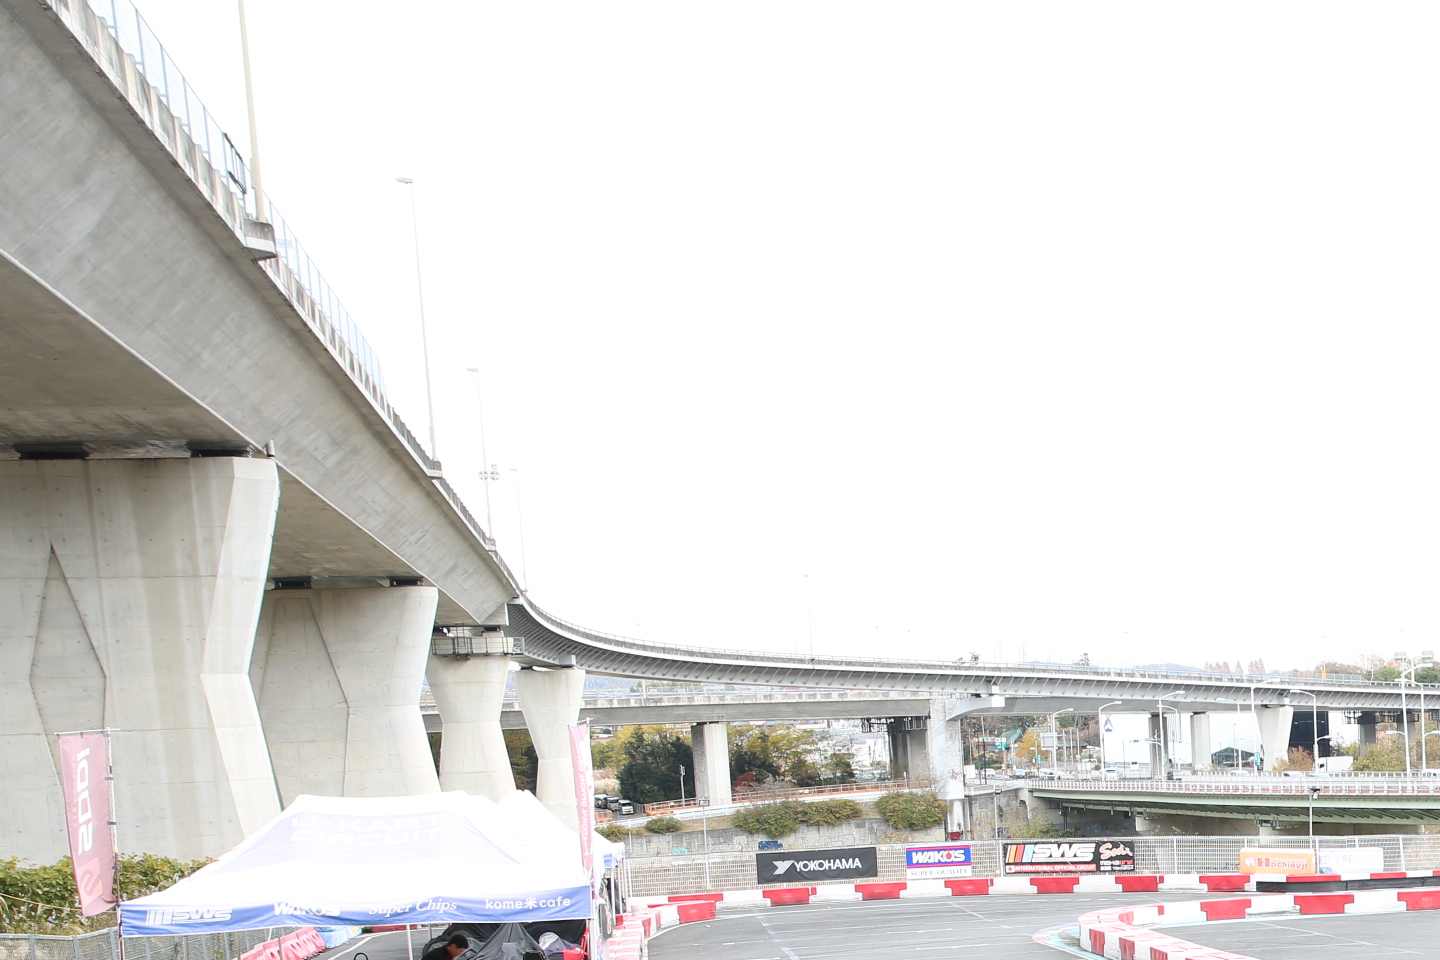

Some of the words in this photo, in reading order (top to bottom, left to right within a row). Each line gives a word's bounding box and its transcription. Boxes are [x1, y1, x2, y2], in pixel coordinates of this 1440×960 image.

[291, 814, 448, 832] U-KART
[290, 828, 448, 846] CIRCUIT
[1032, 843, 1096, 862] SWS
[794, 857, 862, 872] YOKOHAMA
[415, 898, 458, 914] Chips
